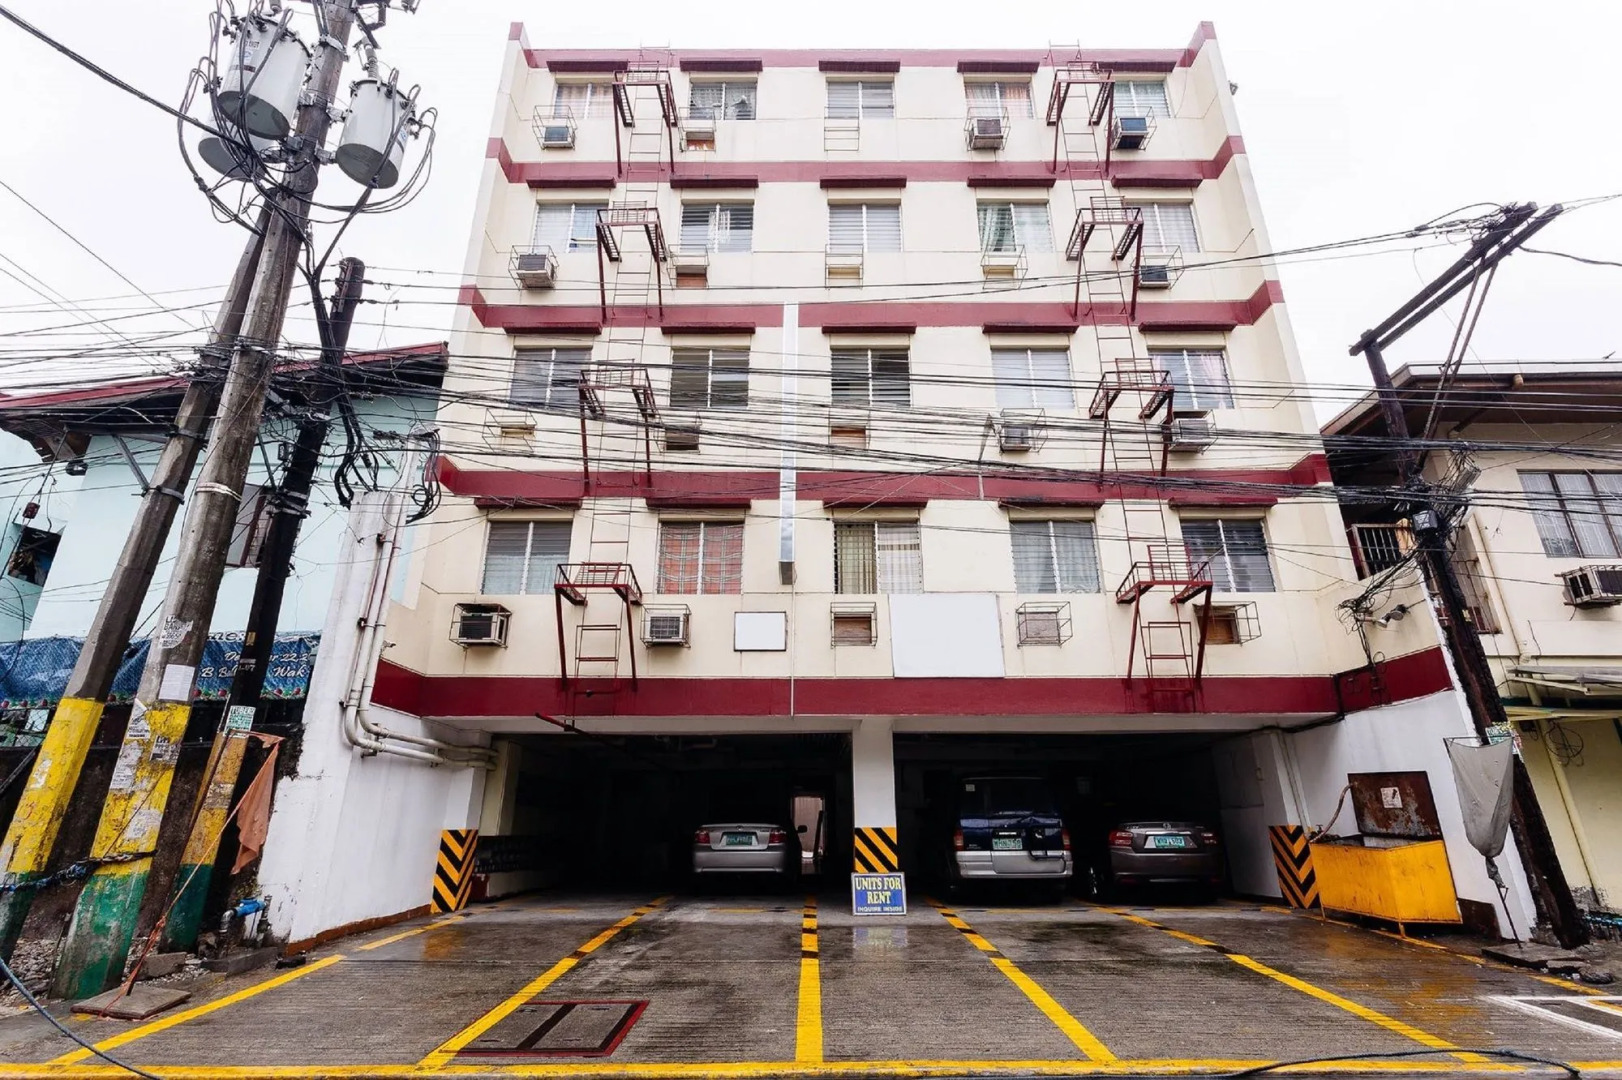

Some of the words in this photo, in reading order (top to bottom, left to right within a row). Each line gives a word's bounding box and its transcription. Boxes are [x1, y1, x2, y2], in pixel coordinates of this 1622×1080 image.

[855, 877, 882, 890] UNITS
[884, 877, 902, 890] FOR
[867, 891, 891, 904] RENT
